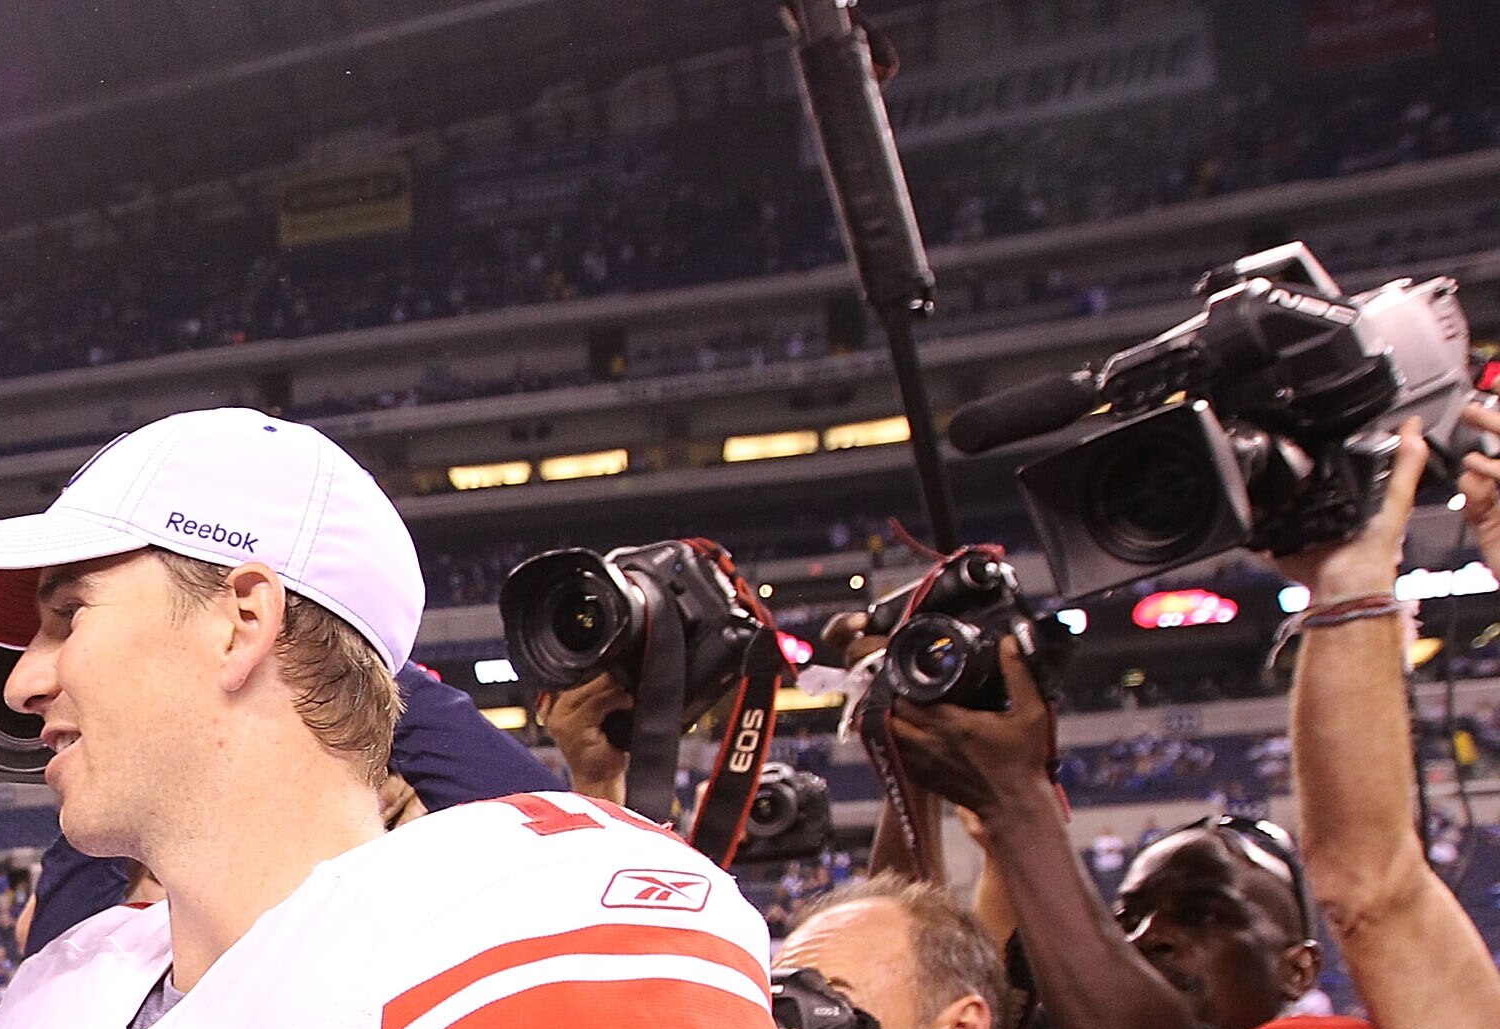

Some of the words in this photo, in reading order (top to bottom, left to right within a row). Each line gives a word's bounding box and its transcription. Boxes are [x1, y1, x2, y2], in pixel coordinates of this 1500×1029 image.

[887, 34, 1202, 129] IDGESTONE
[166, 511, 259, 554] Reebok
[729, 708, 764, 774] EOS
